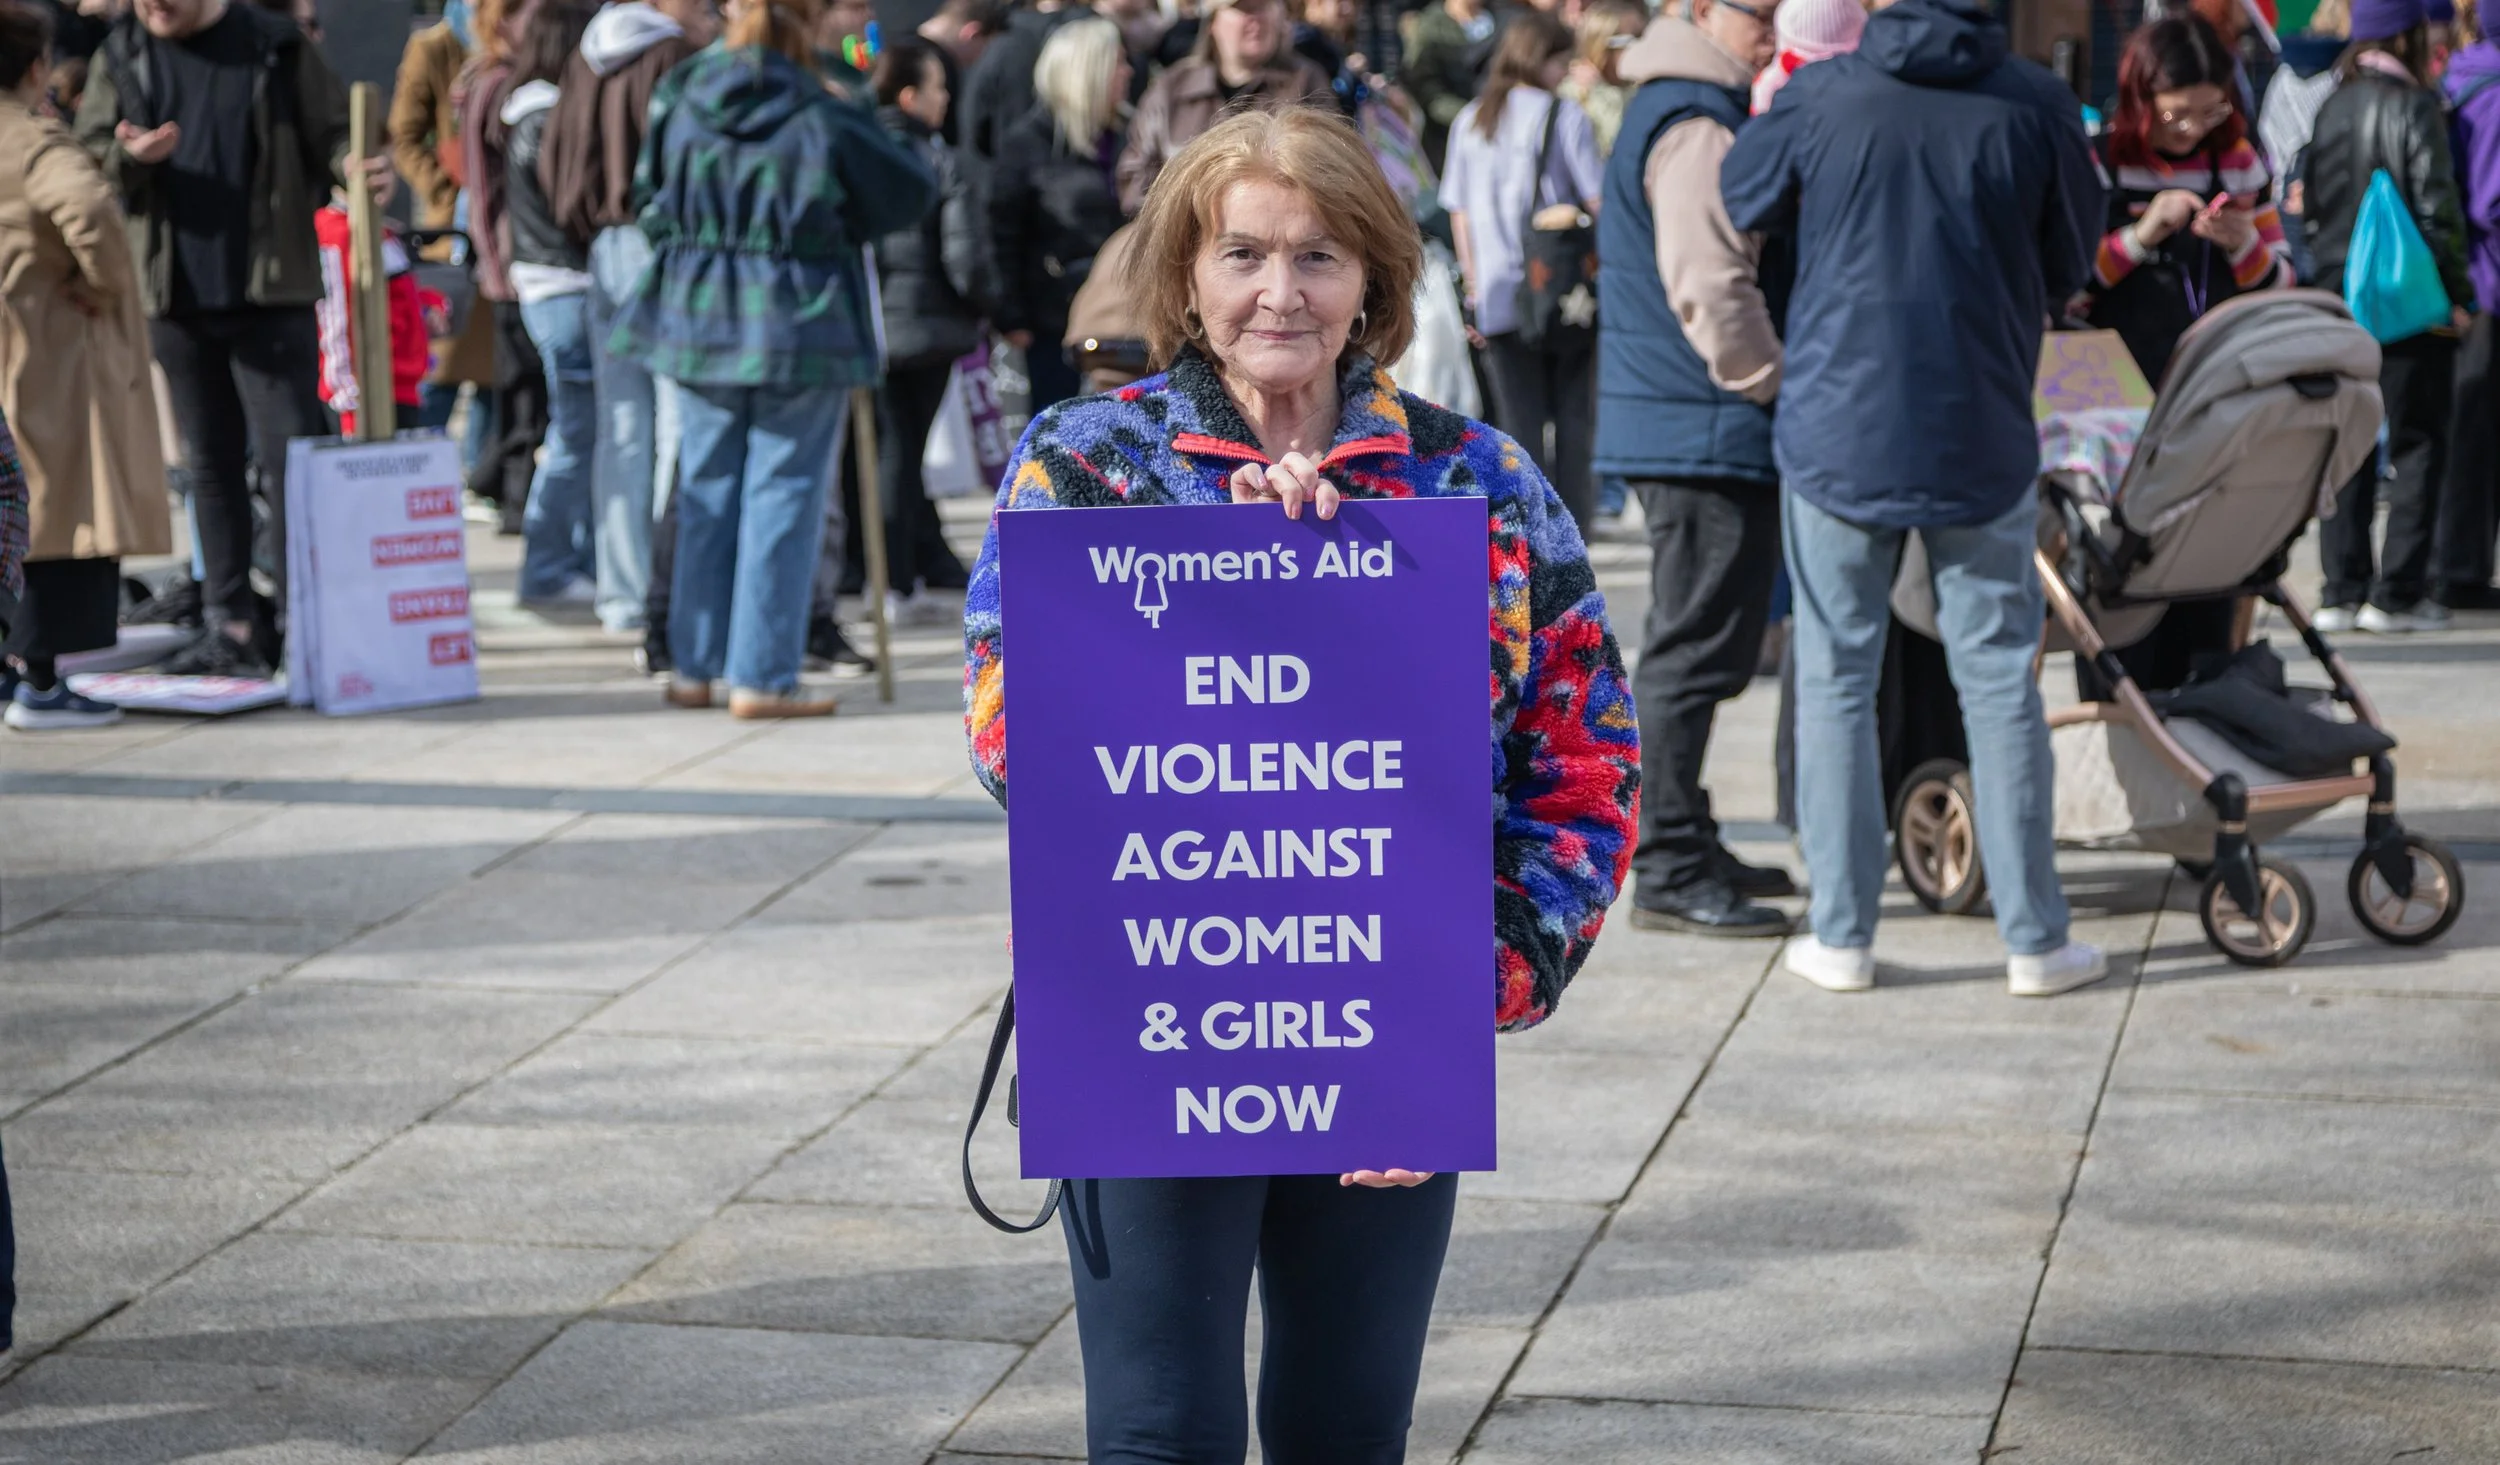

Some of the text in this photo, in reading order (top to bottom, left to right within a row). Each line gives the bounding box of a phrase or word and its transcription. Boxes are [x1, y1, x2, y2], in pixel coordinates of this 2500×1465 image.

[1312, 541, 1393, 579] Aid
[1185, 654, 1311, 706] END
[1093, 740, 1404, 795] VIOLENCE
[1111, 827, 1392, 881] AGAINST
[1123, 914, 1382, 966] WOMEN
[1139, 999, 1374, 1052] & GIRLS
[1175, 1084, 1341, 1134] NOW
